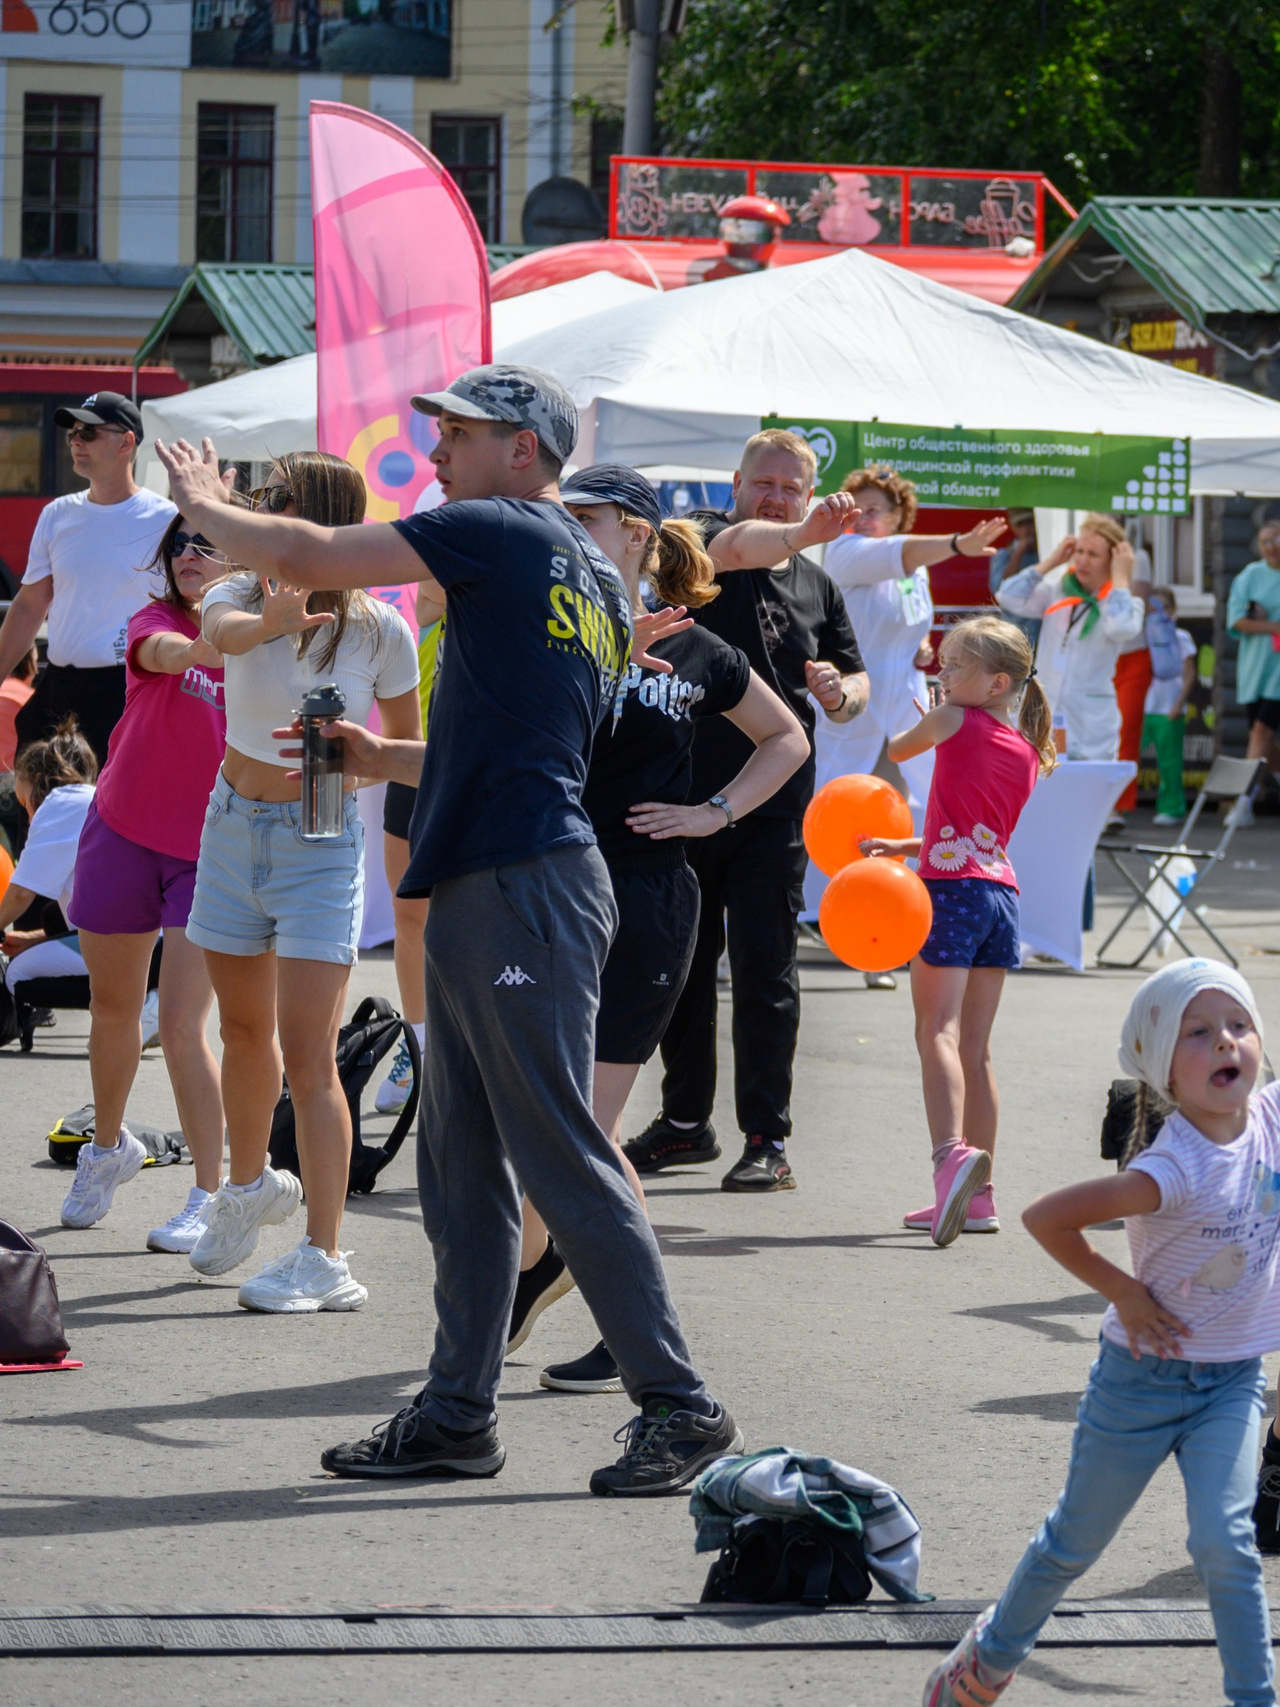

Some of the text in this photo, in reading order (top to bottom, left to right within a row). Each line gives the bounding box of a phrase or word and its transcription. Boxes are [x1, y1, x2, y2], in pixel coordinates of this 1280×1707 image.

[49, 0, 152, 40] 650
[863, 432, 1090, 457] Центр общественного здоровья
[974, 461, 1075, 478] профилактики
[941, 482, 999, 497] области
